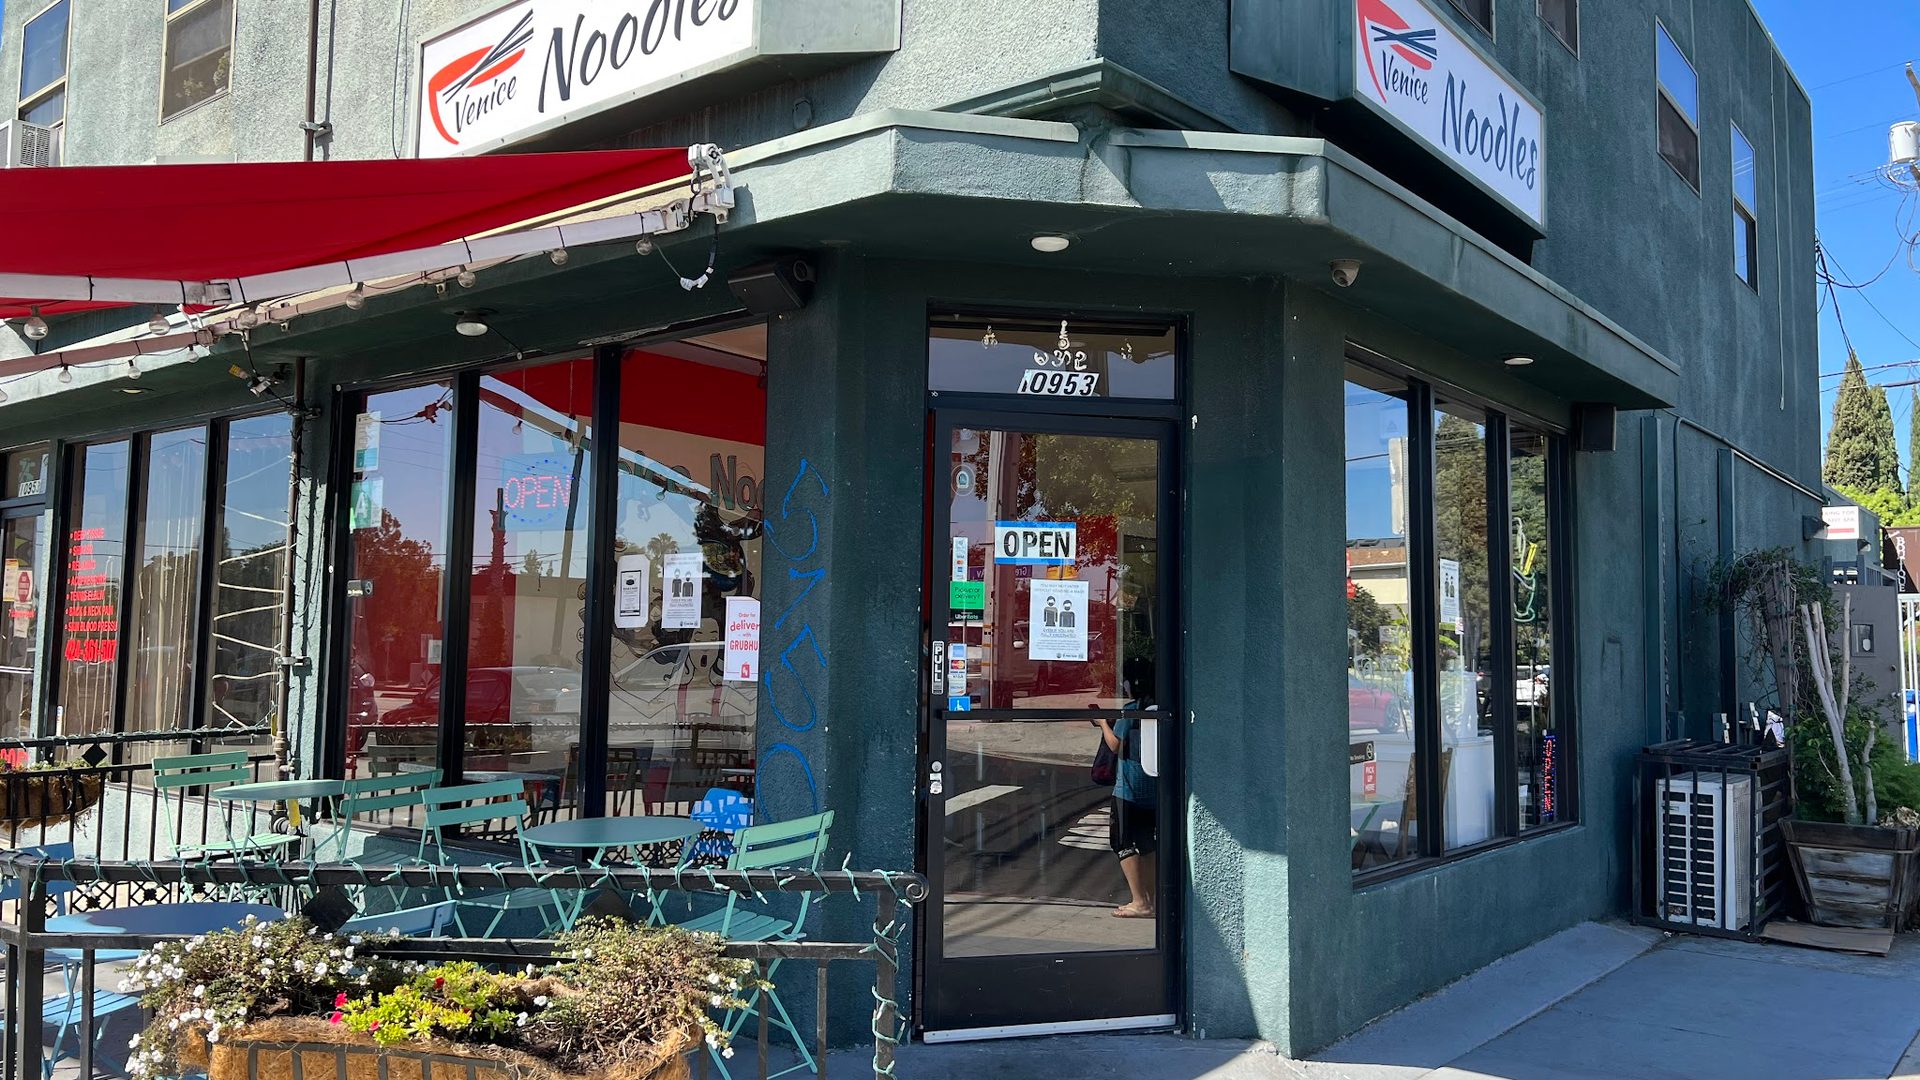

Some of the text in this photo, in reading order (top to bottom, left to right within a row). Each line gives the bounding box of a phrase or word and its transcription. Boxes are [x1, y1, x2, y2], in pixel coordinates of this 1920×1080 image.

[455, 75, 517, 134] Venice
[1382, 49, 1538, 191] Venice Noodles
[504, 474, 571, 509] OPEN
[1003, 530, 1070, 557] OPEN
[730, 640, 759, 651] GRUBHU
[934, 645, 942, 682] PULL
